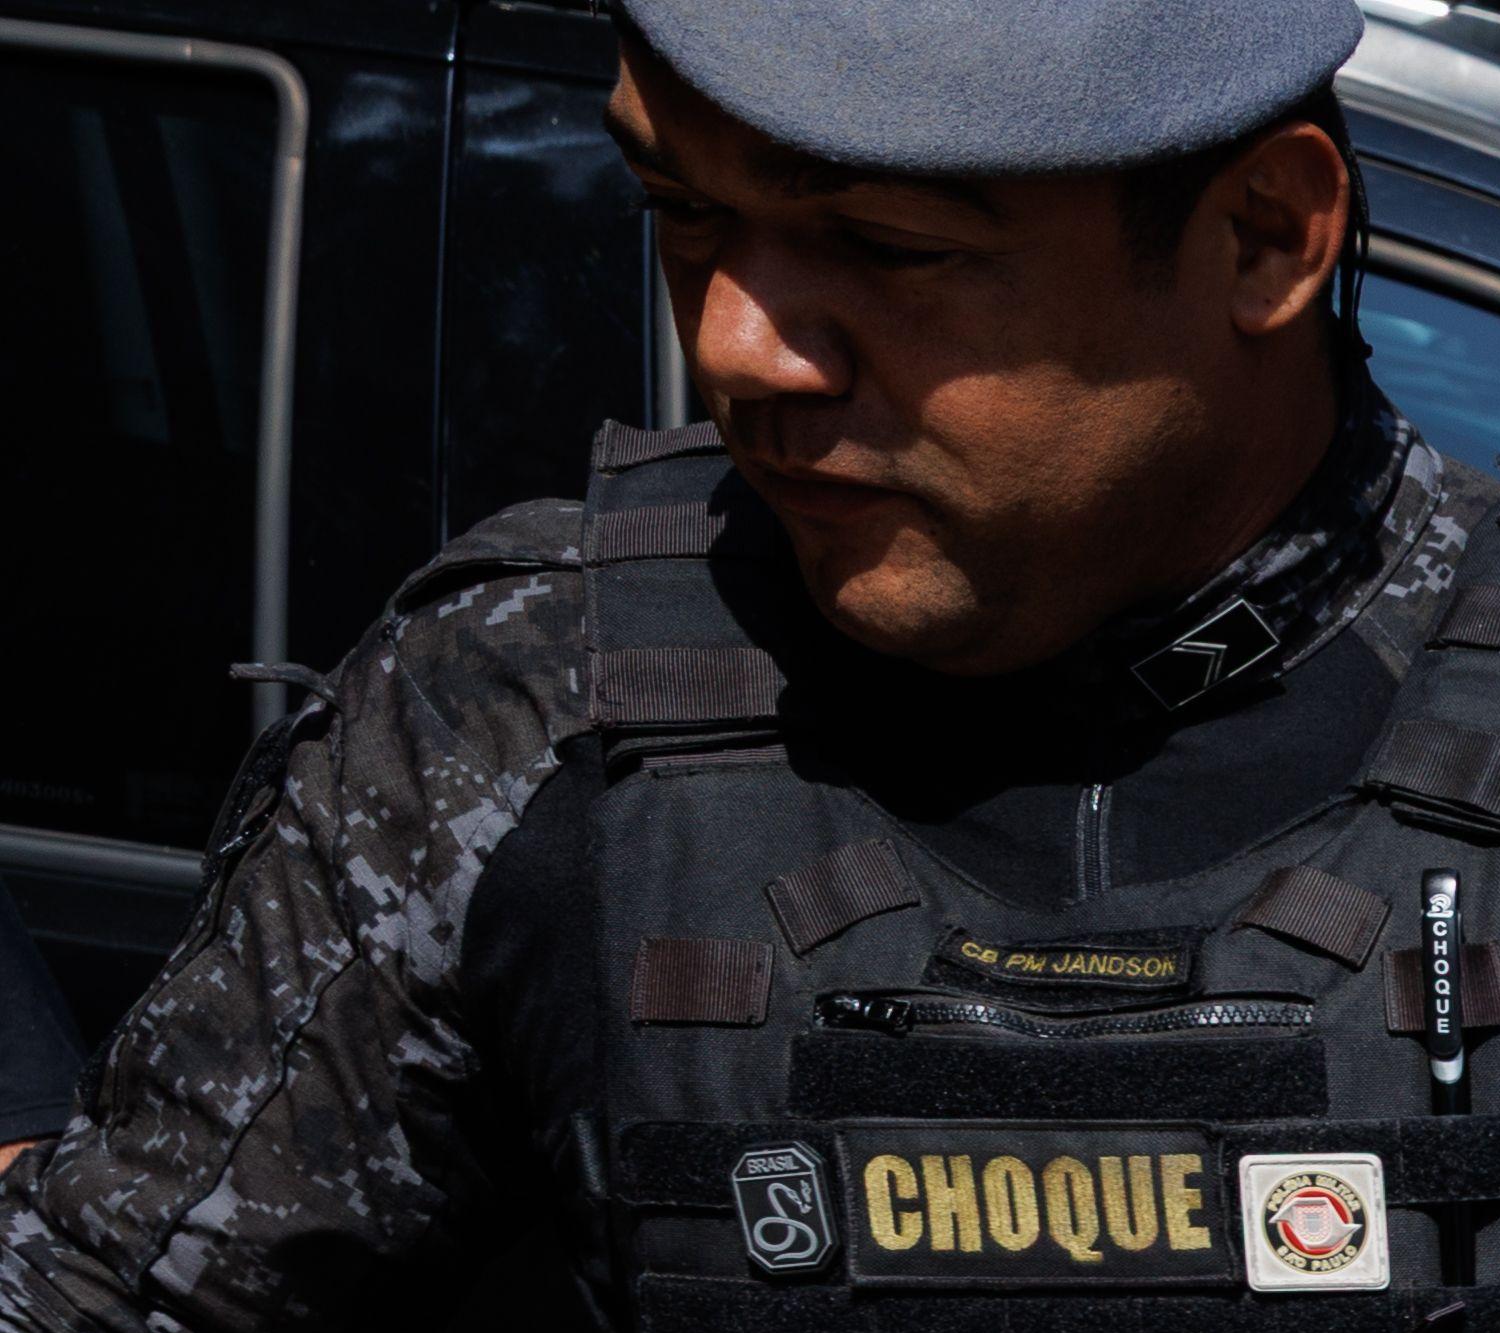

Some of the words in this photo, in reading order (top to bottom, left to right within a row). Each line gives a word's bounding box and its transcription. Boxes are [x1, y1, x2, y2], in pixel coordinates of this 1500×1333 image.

[961, 941, 998, 964] CB
[1005, 953, 1048, 972] PM
[1052, 953, 1178, 977] JANDSON
[1432, 920, 1451, 1034] CHOQUE
[746, 1154, 801, 1174] BRASIL
[863, 1153, 1213, 1263] CHOQUE
[1310, 1245, 1357, 1271] PAULO
